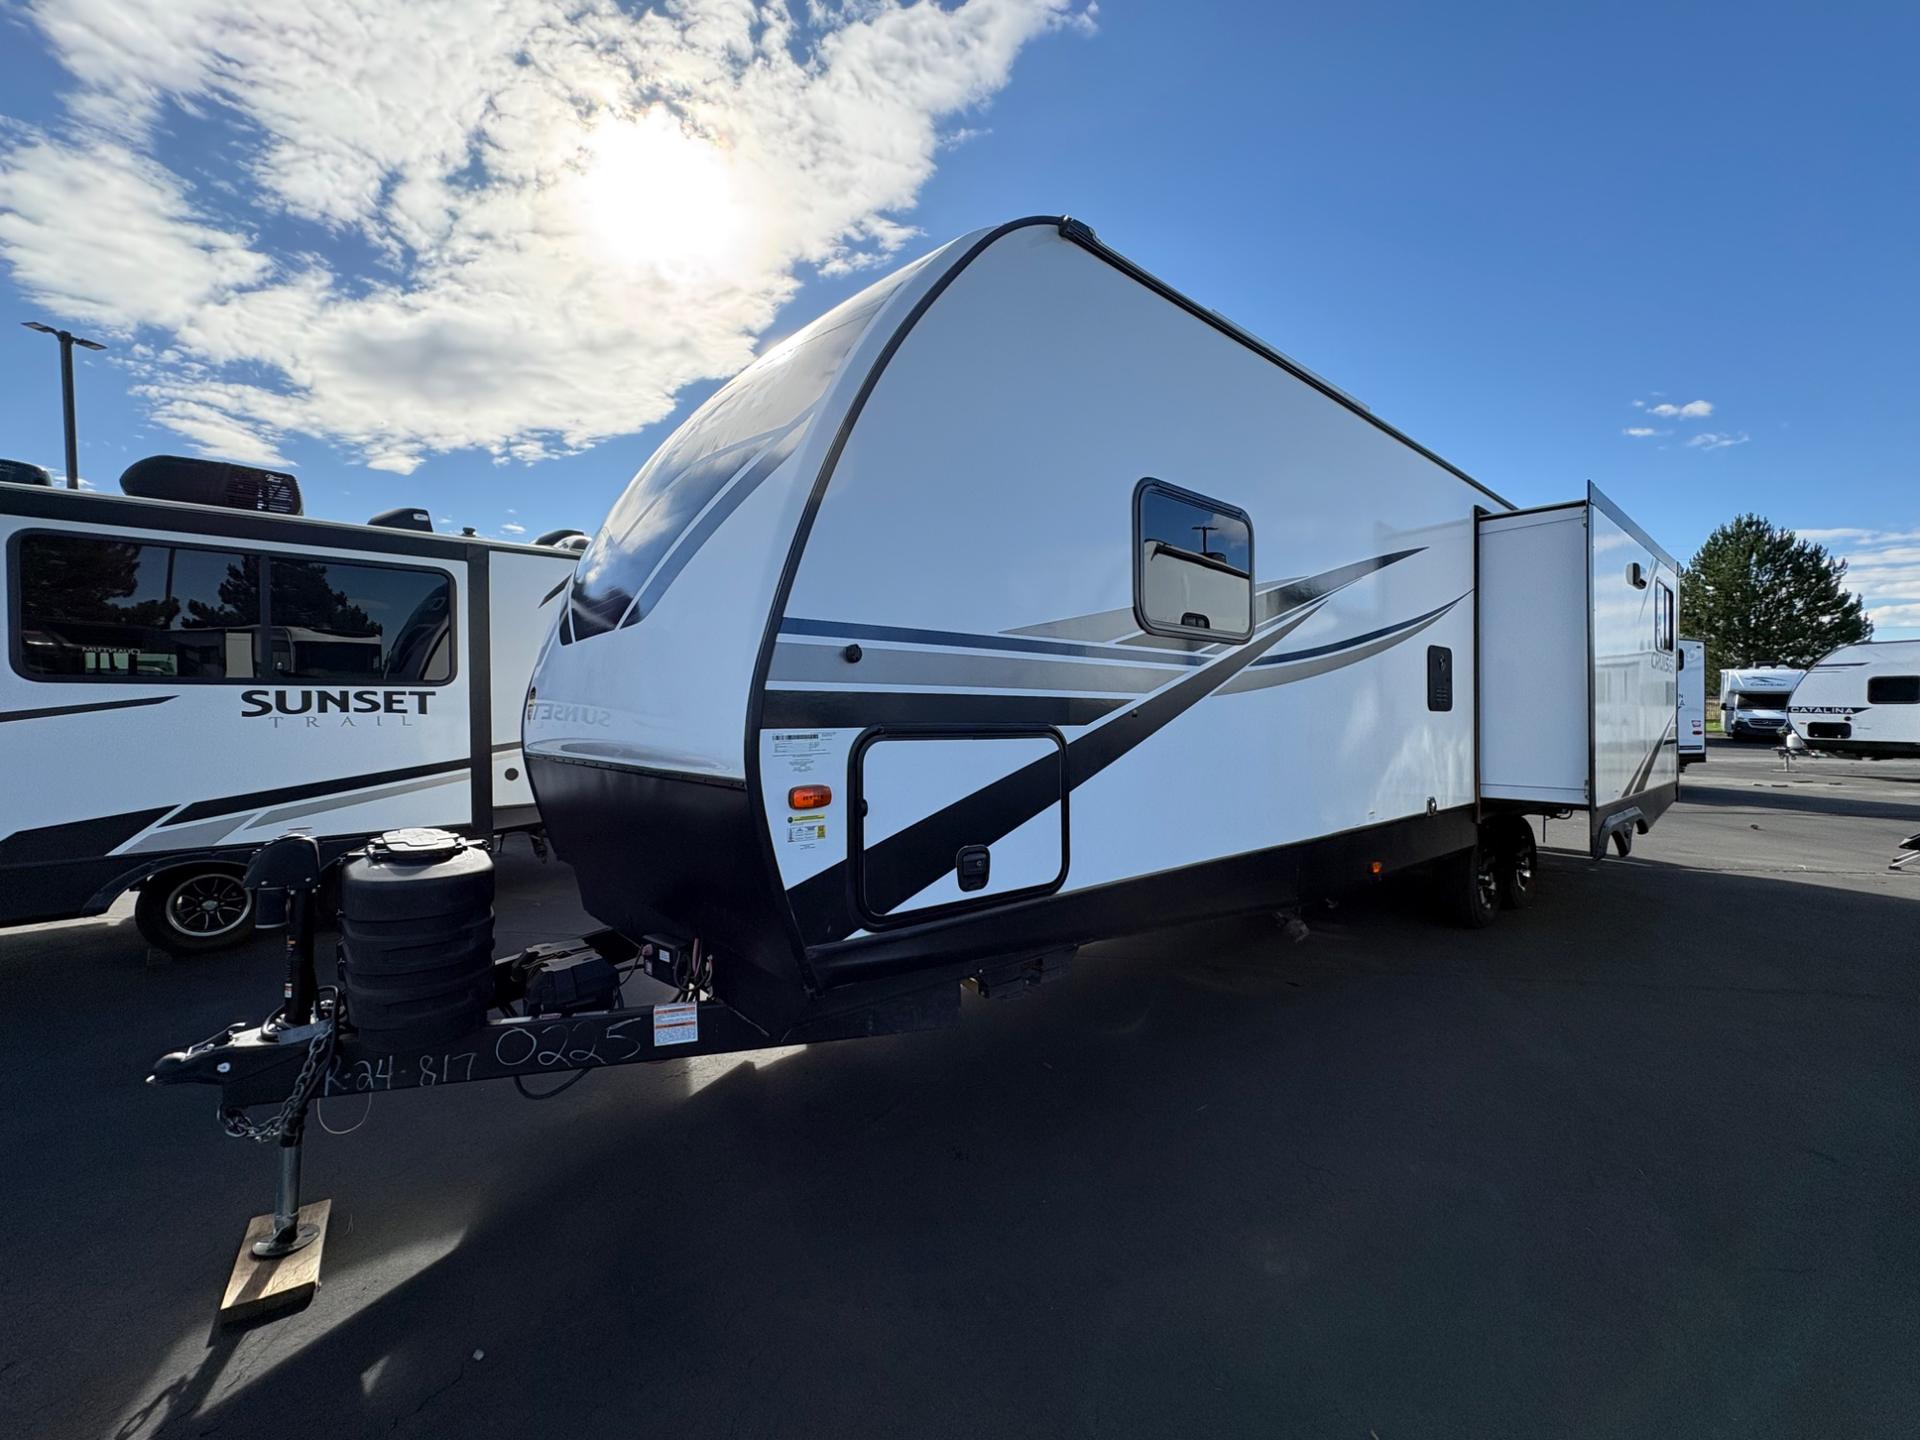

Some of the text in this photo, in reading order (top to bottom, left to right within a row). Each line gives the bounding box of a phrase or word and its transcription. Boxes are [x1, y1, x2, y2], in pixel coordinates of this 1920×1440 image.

[241, 689, 436, 717] SUNSET
[268, 716, 413, 728] TRAIL
[496, 1017, 641, 1067] 0225
